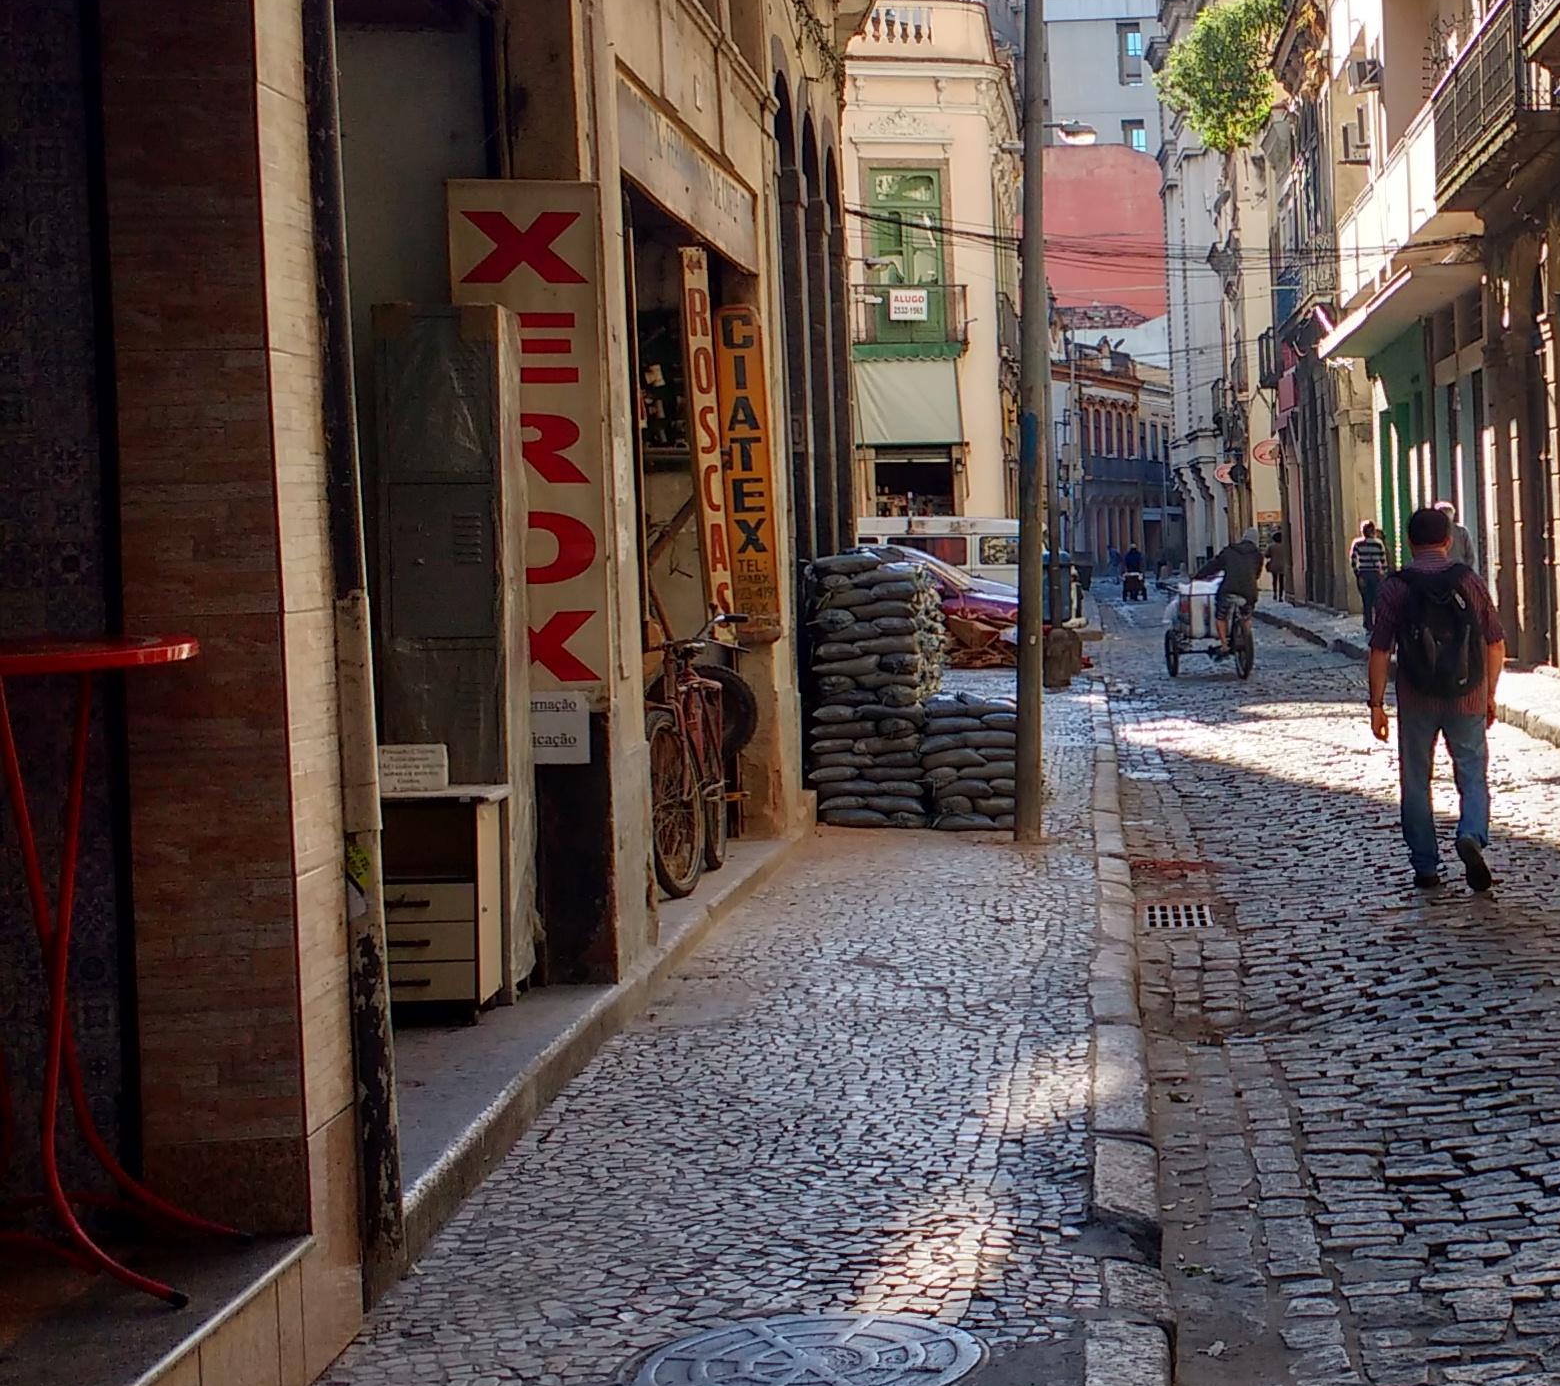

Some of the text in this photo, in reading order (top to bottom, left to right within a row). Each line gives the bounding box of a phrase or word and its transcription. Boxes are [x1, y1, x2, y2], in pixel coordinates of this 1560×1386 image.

[894, 295, 925, 303] ALUGO
[687, 288, 730, 629] ROSCAS
[721, 314, 769, 554] CIATEX
[738, 559, 768, 572] TEL:
